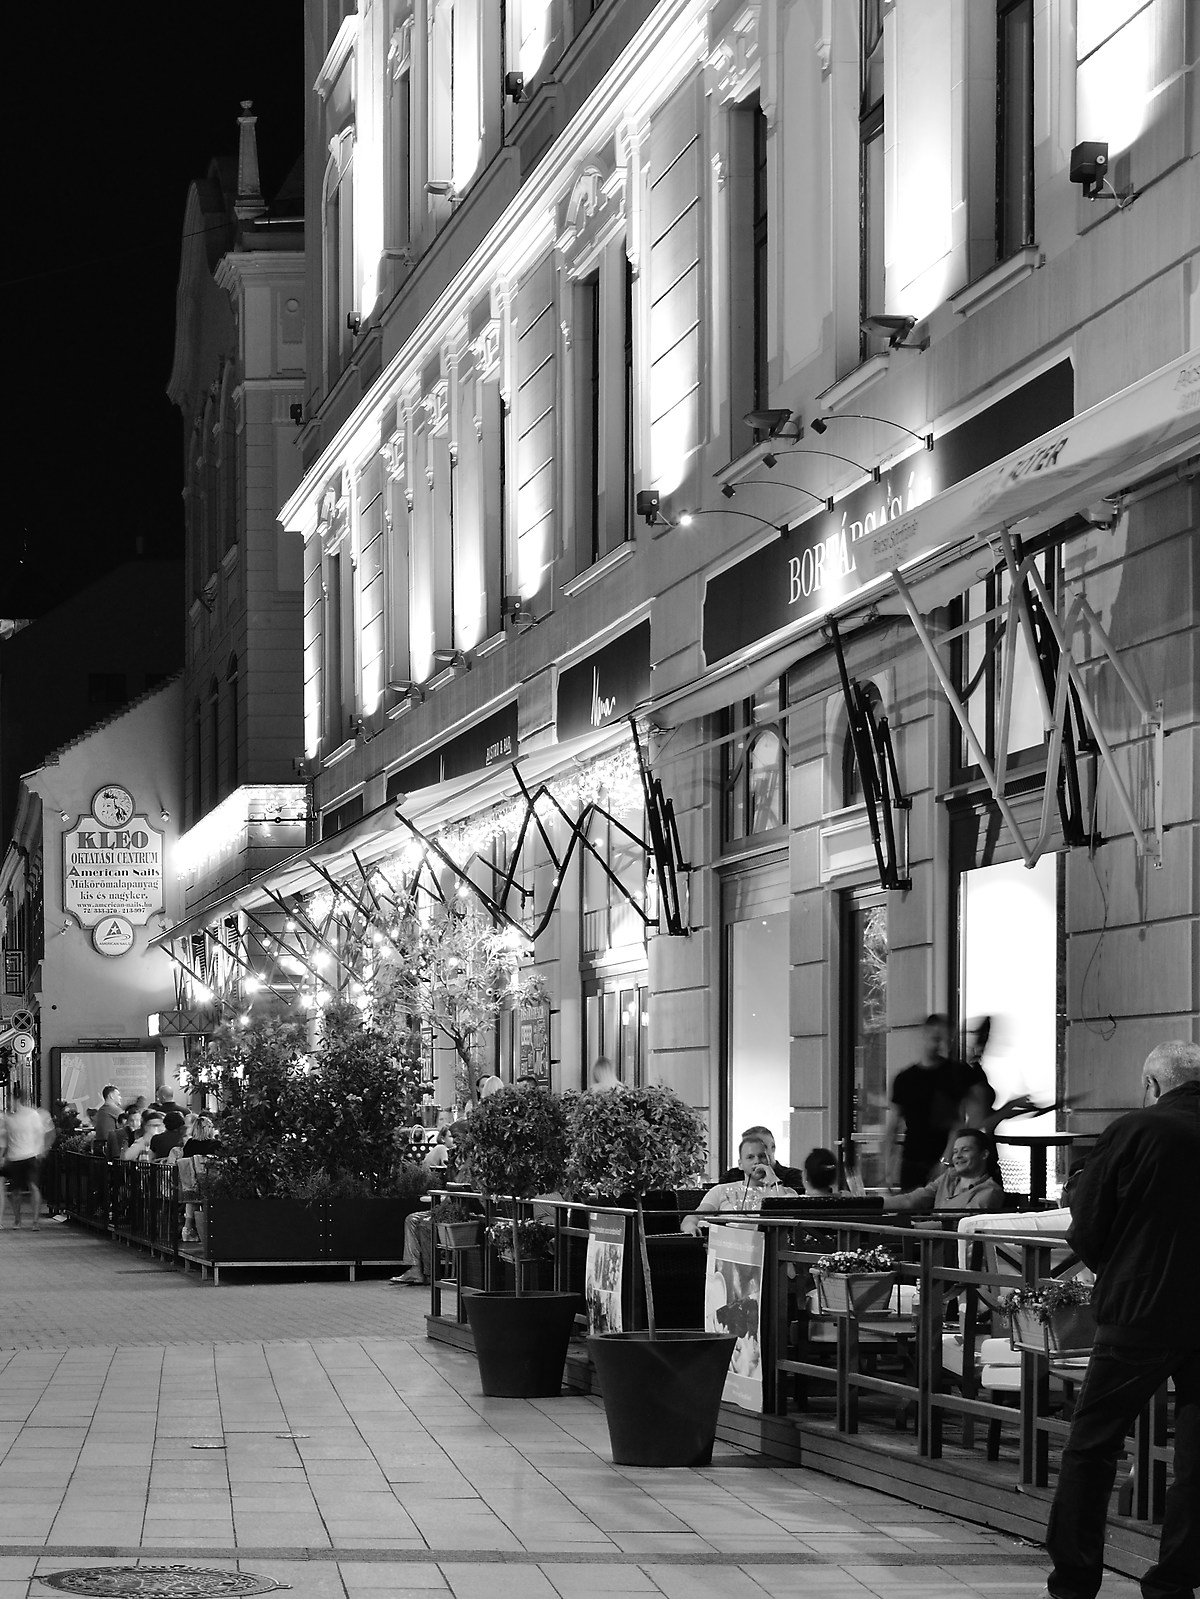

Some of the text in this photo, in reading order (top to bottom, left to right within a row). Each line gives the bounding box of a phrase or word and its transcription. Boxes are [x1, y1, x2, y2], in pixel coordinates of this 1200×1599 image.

[76, 830, 149, 850] KLEO
[71, 850, 158, 865] OKTATÁSI CENTRUM
[67, 865, 129, 877] American
[80, 891, 94, 900] kis
[96, 891, 106, 900] és
[20, 1039, 26, 1048] 5
